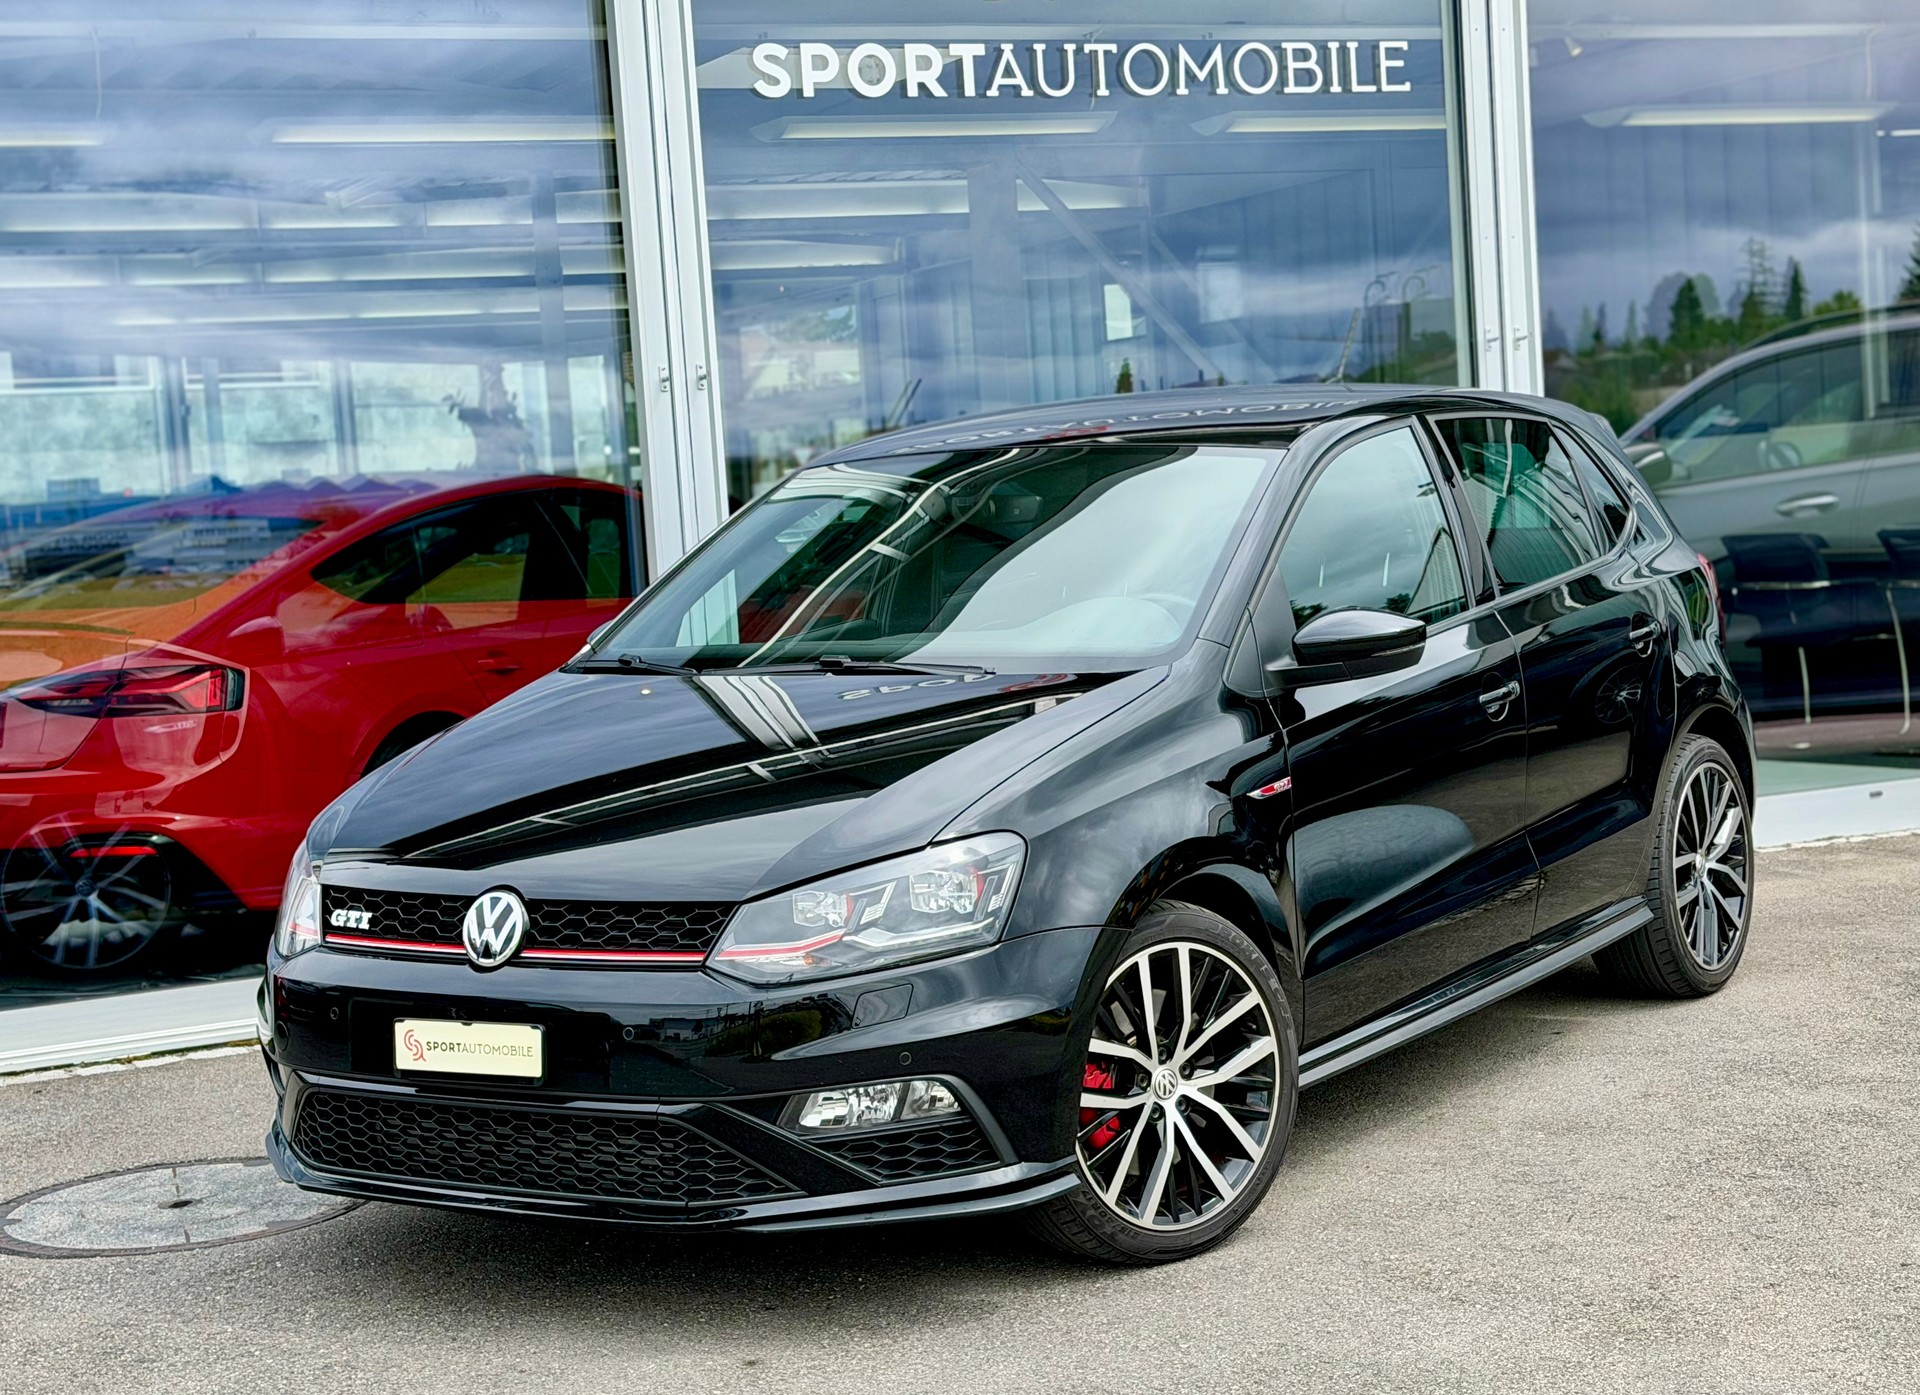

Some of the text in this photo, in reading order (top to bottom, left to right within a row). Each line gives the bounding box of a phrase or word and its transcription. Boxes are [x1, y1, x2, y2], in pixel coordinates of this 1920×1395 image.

[752, 40, 1411, 98] SPORTAUTOMOBILE
[330, 909, 373, 930] GTI
[426, 1041, 534, 1057] SPORTAUTOMOBILE
